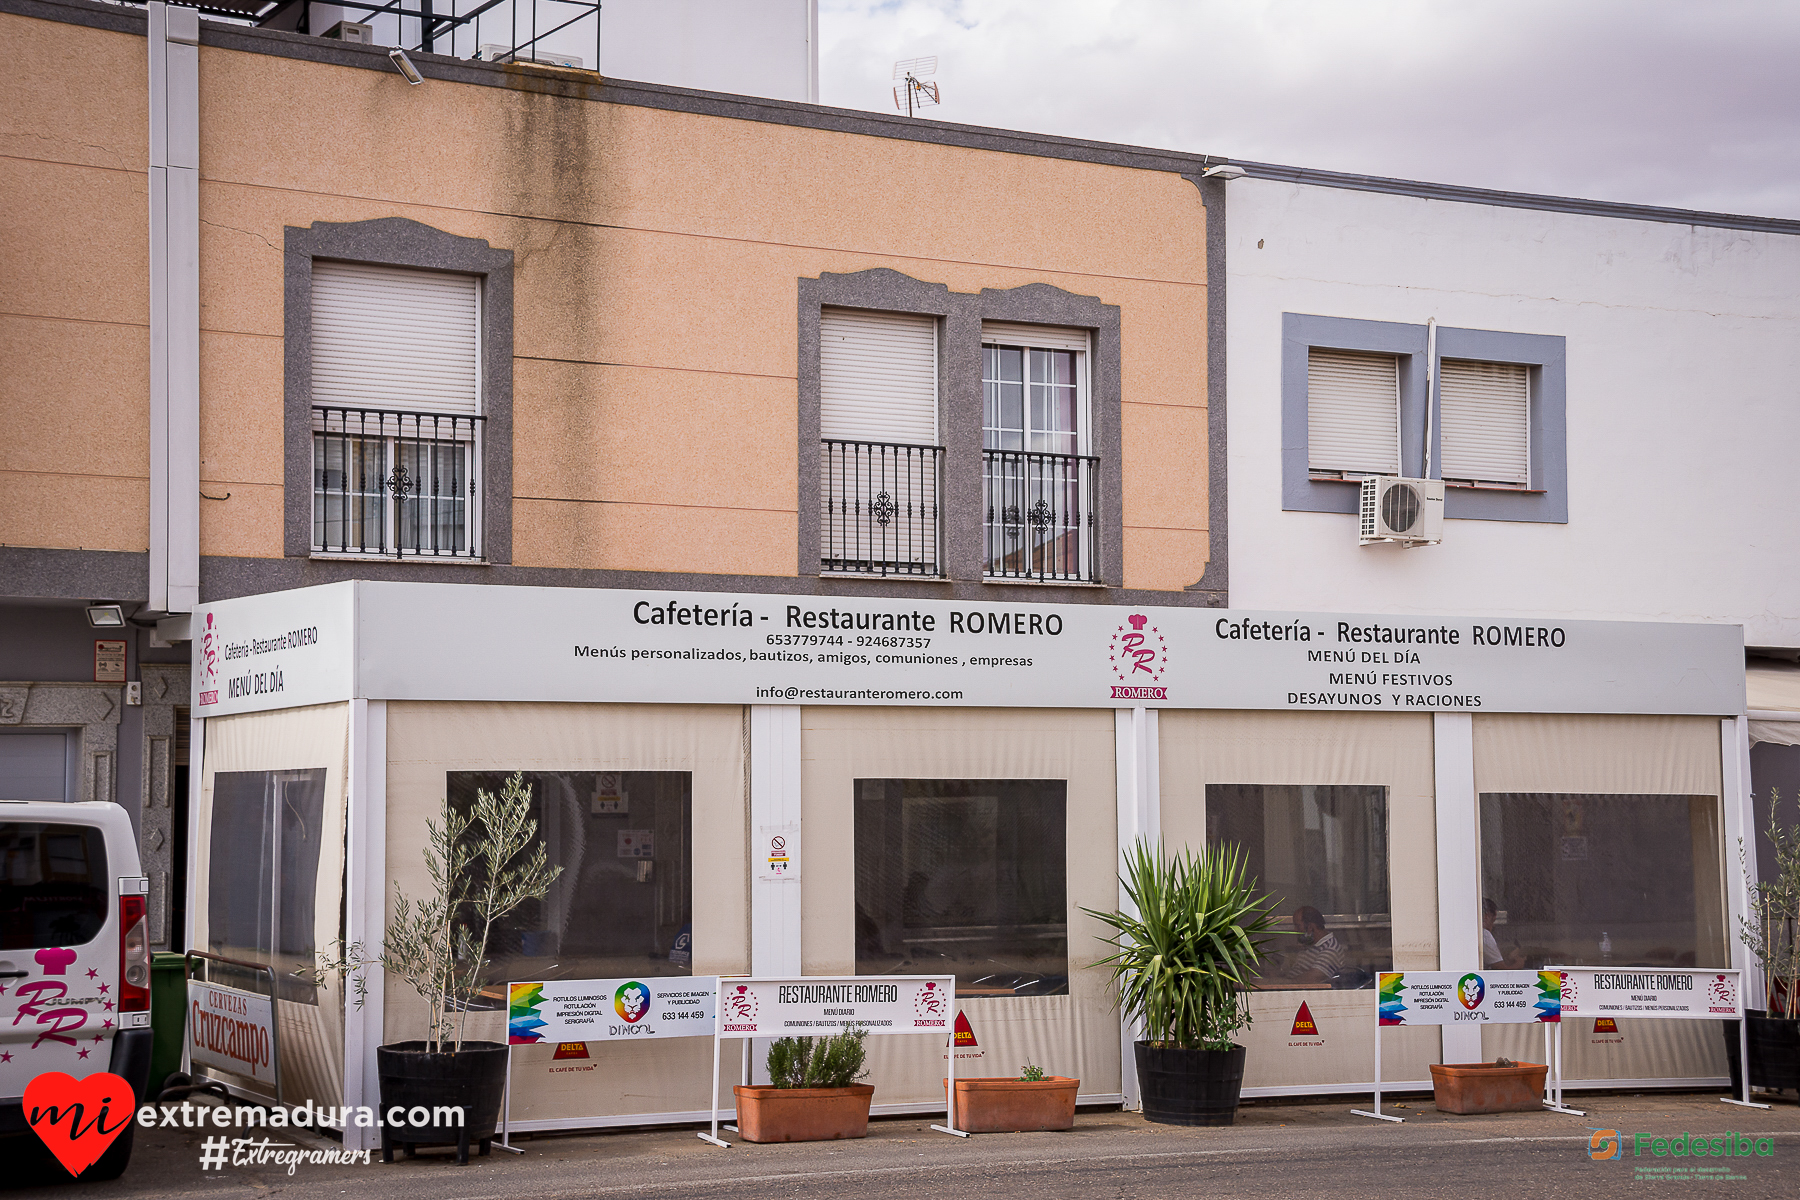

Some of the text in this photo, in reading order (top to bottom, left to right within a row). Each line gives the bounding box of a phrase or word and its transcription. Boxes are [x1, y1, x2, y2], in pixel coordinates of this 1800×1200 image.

[633, 601, 752, 627] Cafetería
[787, 605, 935, 631] Restaurante
[950, 611, 1063, 636] ROMERO
[766, 634, 843, 647] 653779744
[856, 636, 931, 648] 924687357
[1215, 618, 1311, 642] Cafetería
[1337, 621, 1460, 645] Restaurante
[1472, 625, 1566, 648] ROMERO
[225, 640, 249, 660] Cafetería
[288, 626, 318, 649] ROMERO
[574, 646, 627, 658] Menús
[631, 647, 747, 663] personalizados,
[750, 649, 813, 664] bautizos,
[817, 652, 871, 666] amigos,
[875, 654, 958, 665] comuniones
[970, 656, 1033, 668] empresas
[1308, 648, 1421, 664] MENÚ DEL DÍA
[229, 664, 284, 699] MENÚ DEL DÍA
[1329, 671, 1453, 686] MENÚ FESTIVOS
[756, 686, 963, 700] info@restauranteromero.com
[1115, 687, 1164, 699] ROMERO
[1288, 692, 1482, 707] DESAYUNOS Y RACIONES
[1594, 974, 1693, 991] RESTAURANTE ROMERO
[45, 996, 106, 1006] JUMPY
[779, 984, 897, 1004] RESTAURANTE ROMERO
[209, 990, 247, 1016] CERVEZAS
[824, 1007, 838, 1015] MENÚ
[662, 1012, 676, 1020] 633
[691, 1011, 704, 1019] 459
[192, 999, 269, 1076] Cruzcampo
[561, 1043, 584, 1051] DELTA
